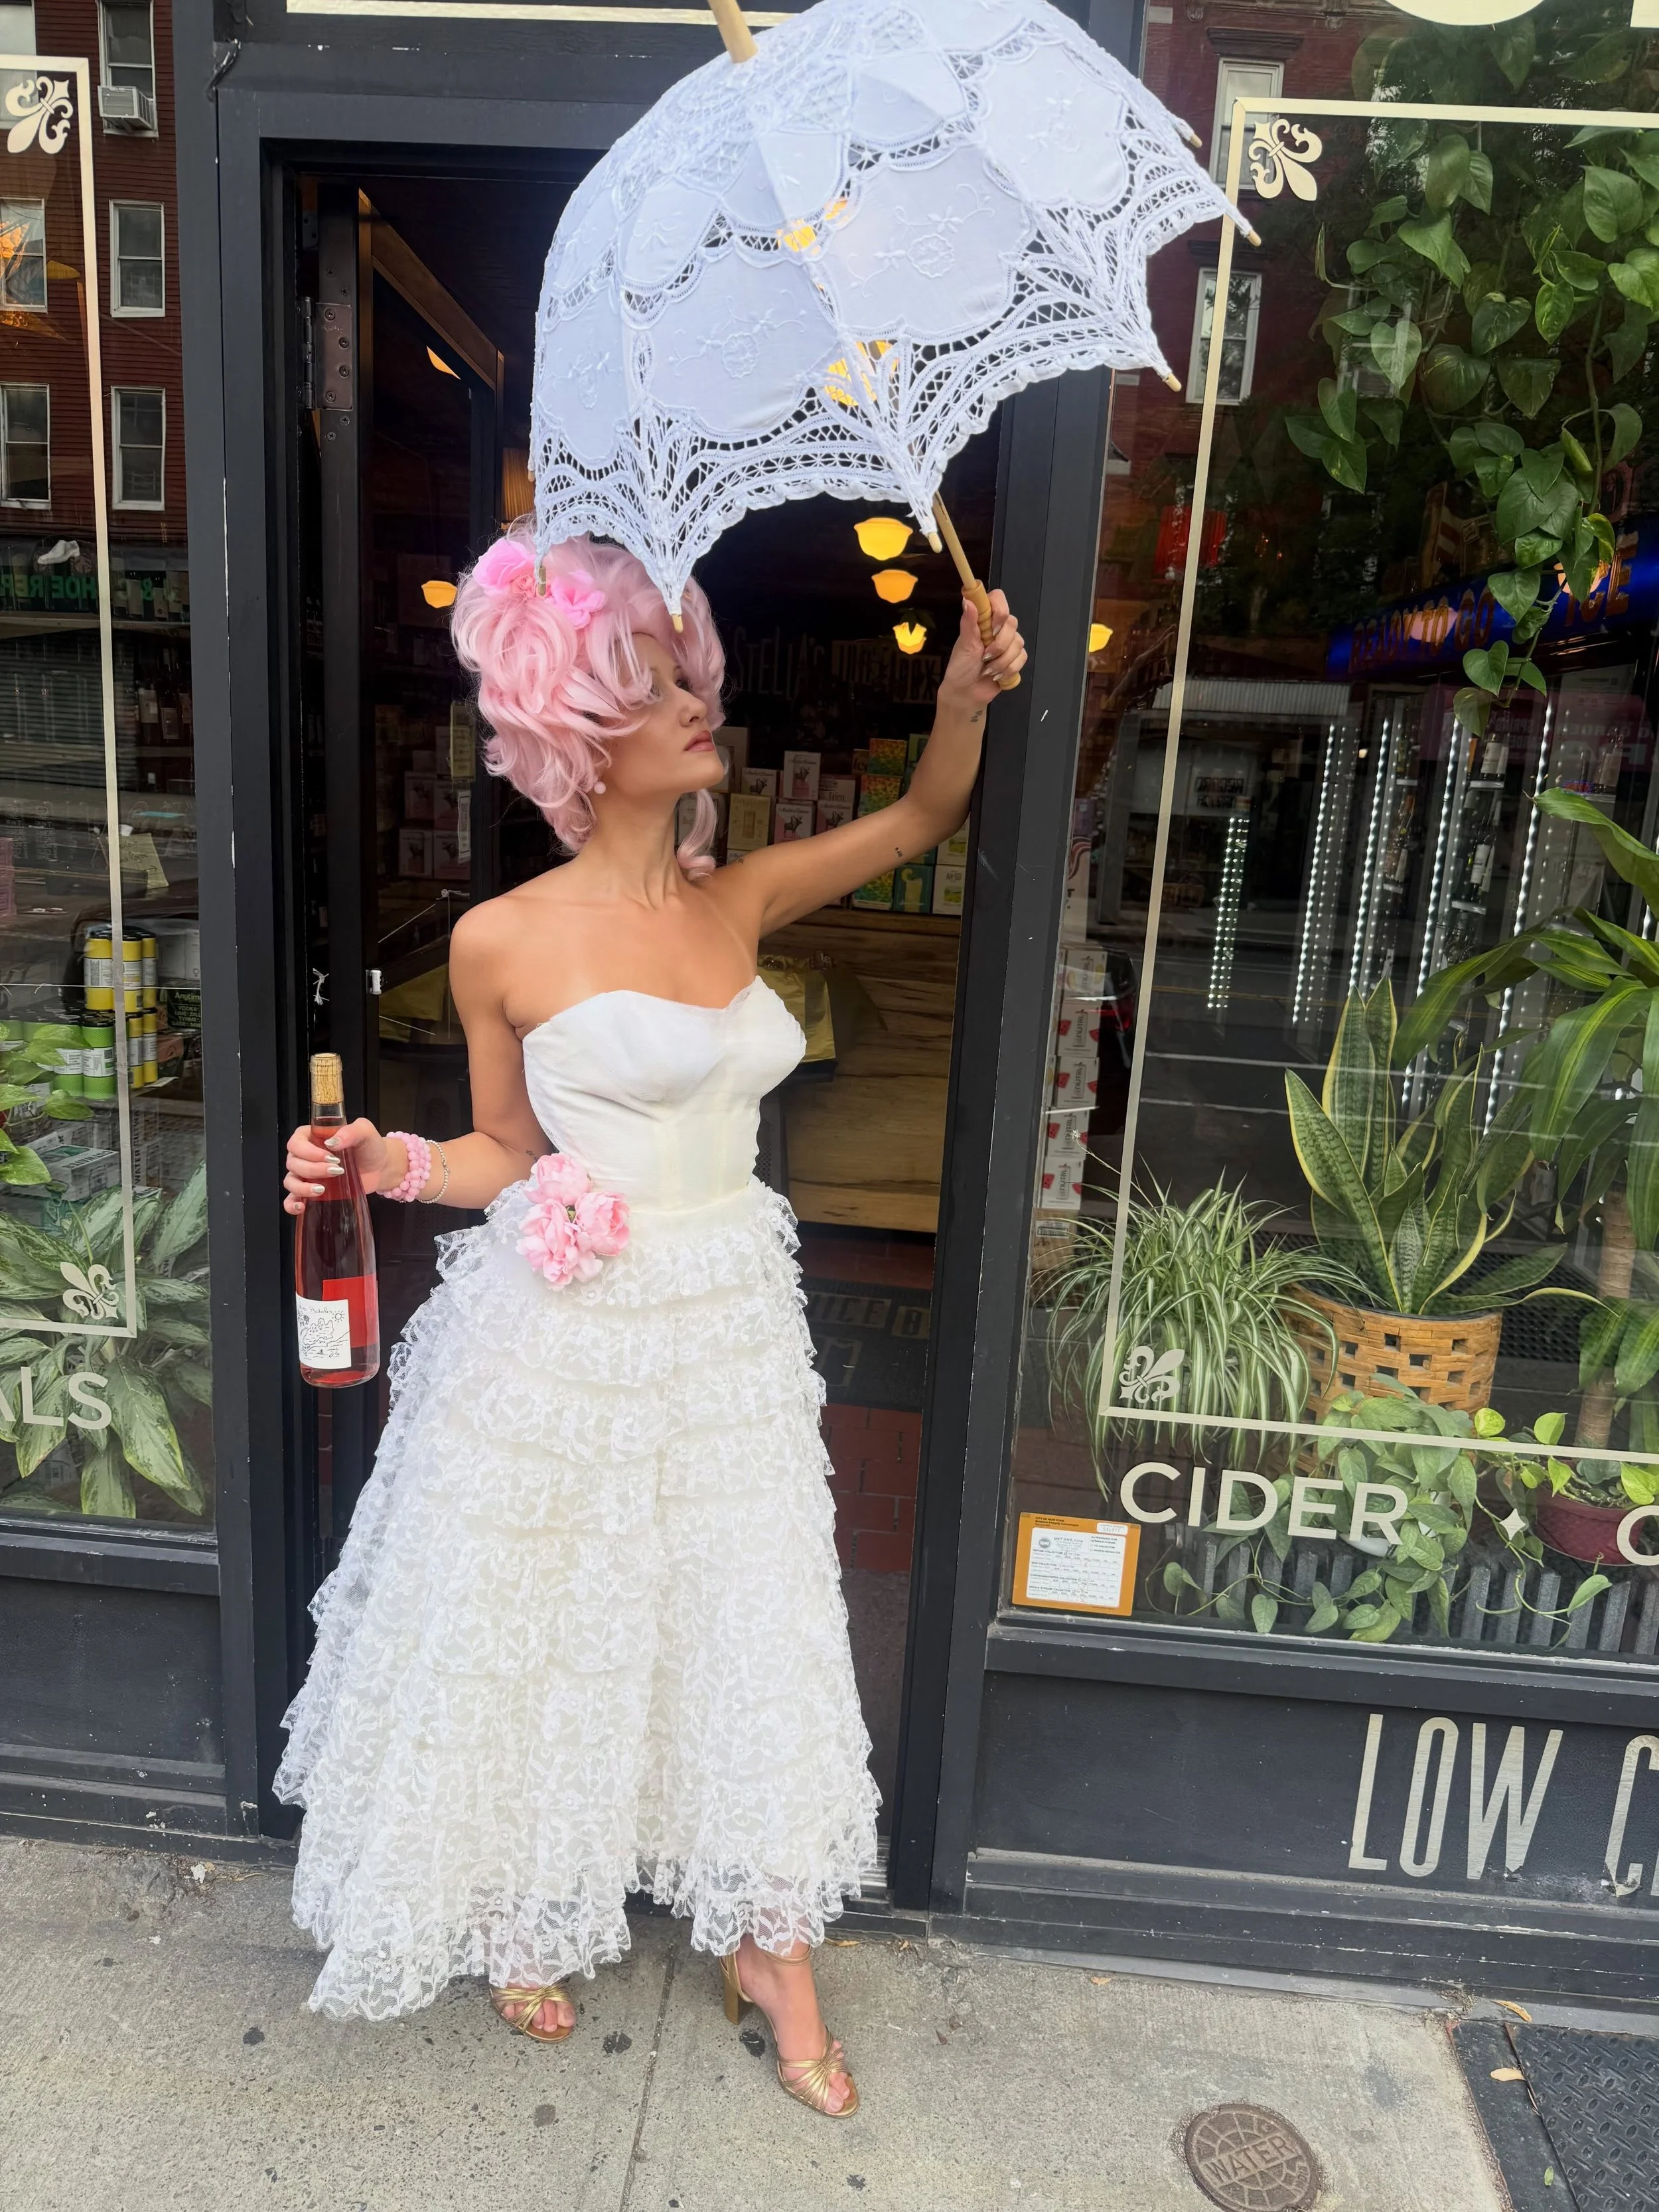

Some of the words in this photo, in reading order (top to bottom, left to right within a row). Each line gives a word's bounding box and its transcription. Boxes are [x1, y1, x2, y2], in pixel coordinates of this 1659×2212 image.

[175, 992, 201, 1001] Anytim
[1120, 1461, 1409, 1544] CIDER
[1348, 1714, 1564, 1881] LOW
[1602, 1734, 1659, 1897] C
[1202, 2134, 1297, 2184] WATER
